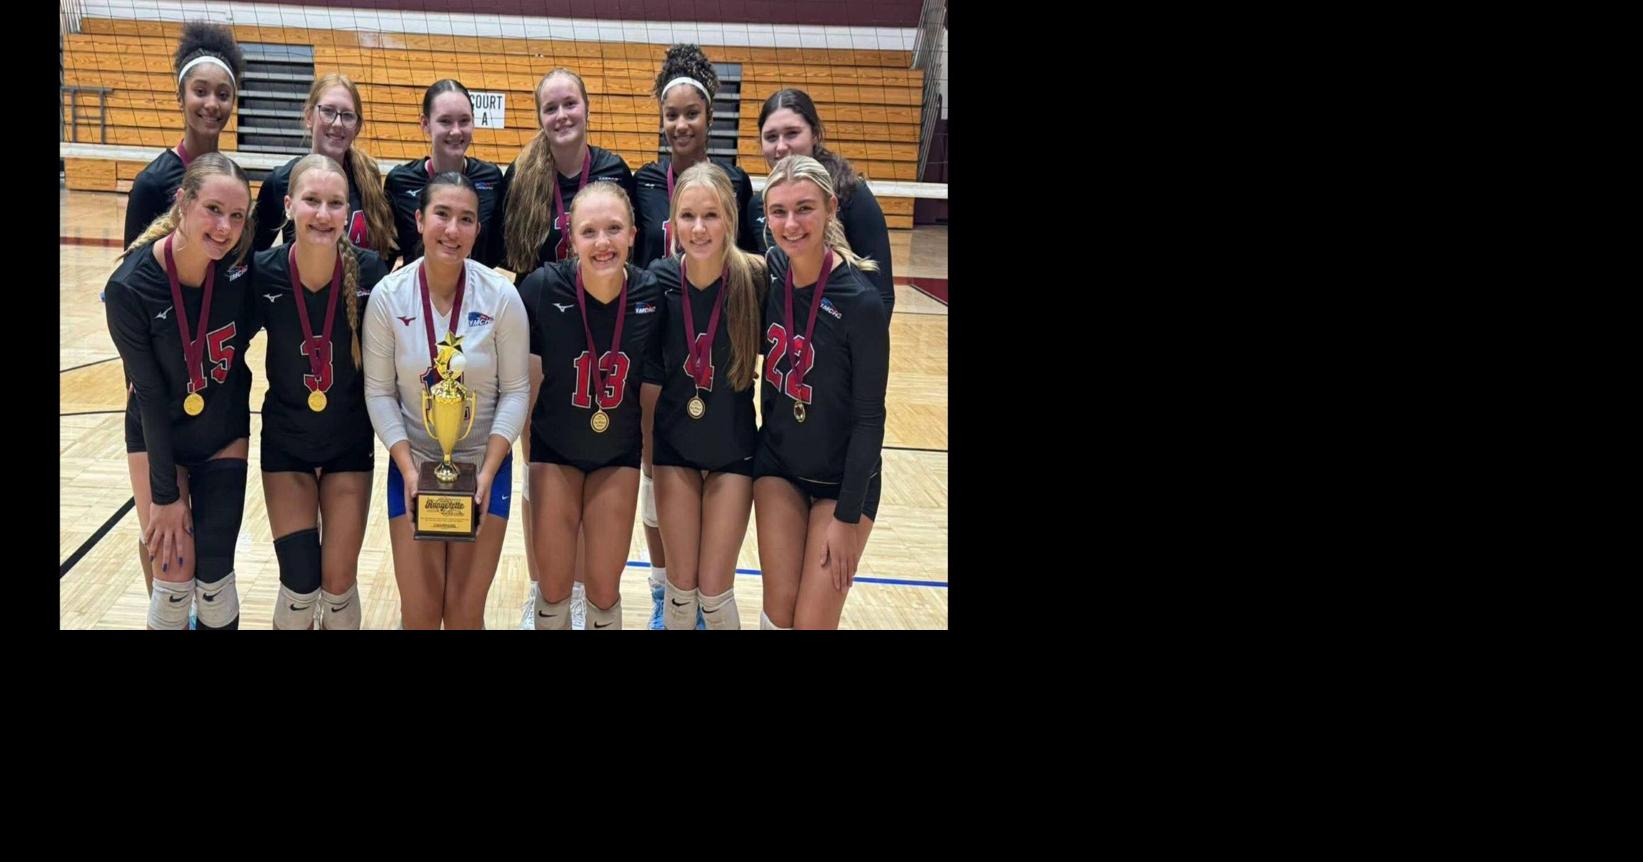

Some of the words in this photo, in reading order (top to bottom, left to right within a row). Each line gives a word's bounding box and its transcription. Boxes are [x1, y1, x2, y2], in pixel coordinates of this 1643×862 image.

[482, 111, 488, 126] A
[300, 335, 334, 393] 3
[571, 351, 630, 409] 13
[683, 333, 714, 392] 4
[765, 322, 815, 404] 22
